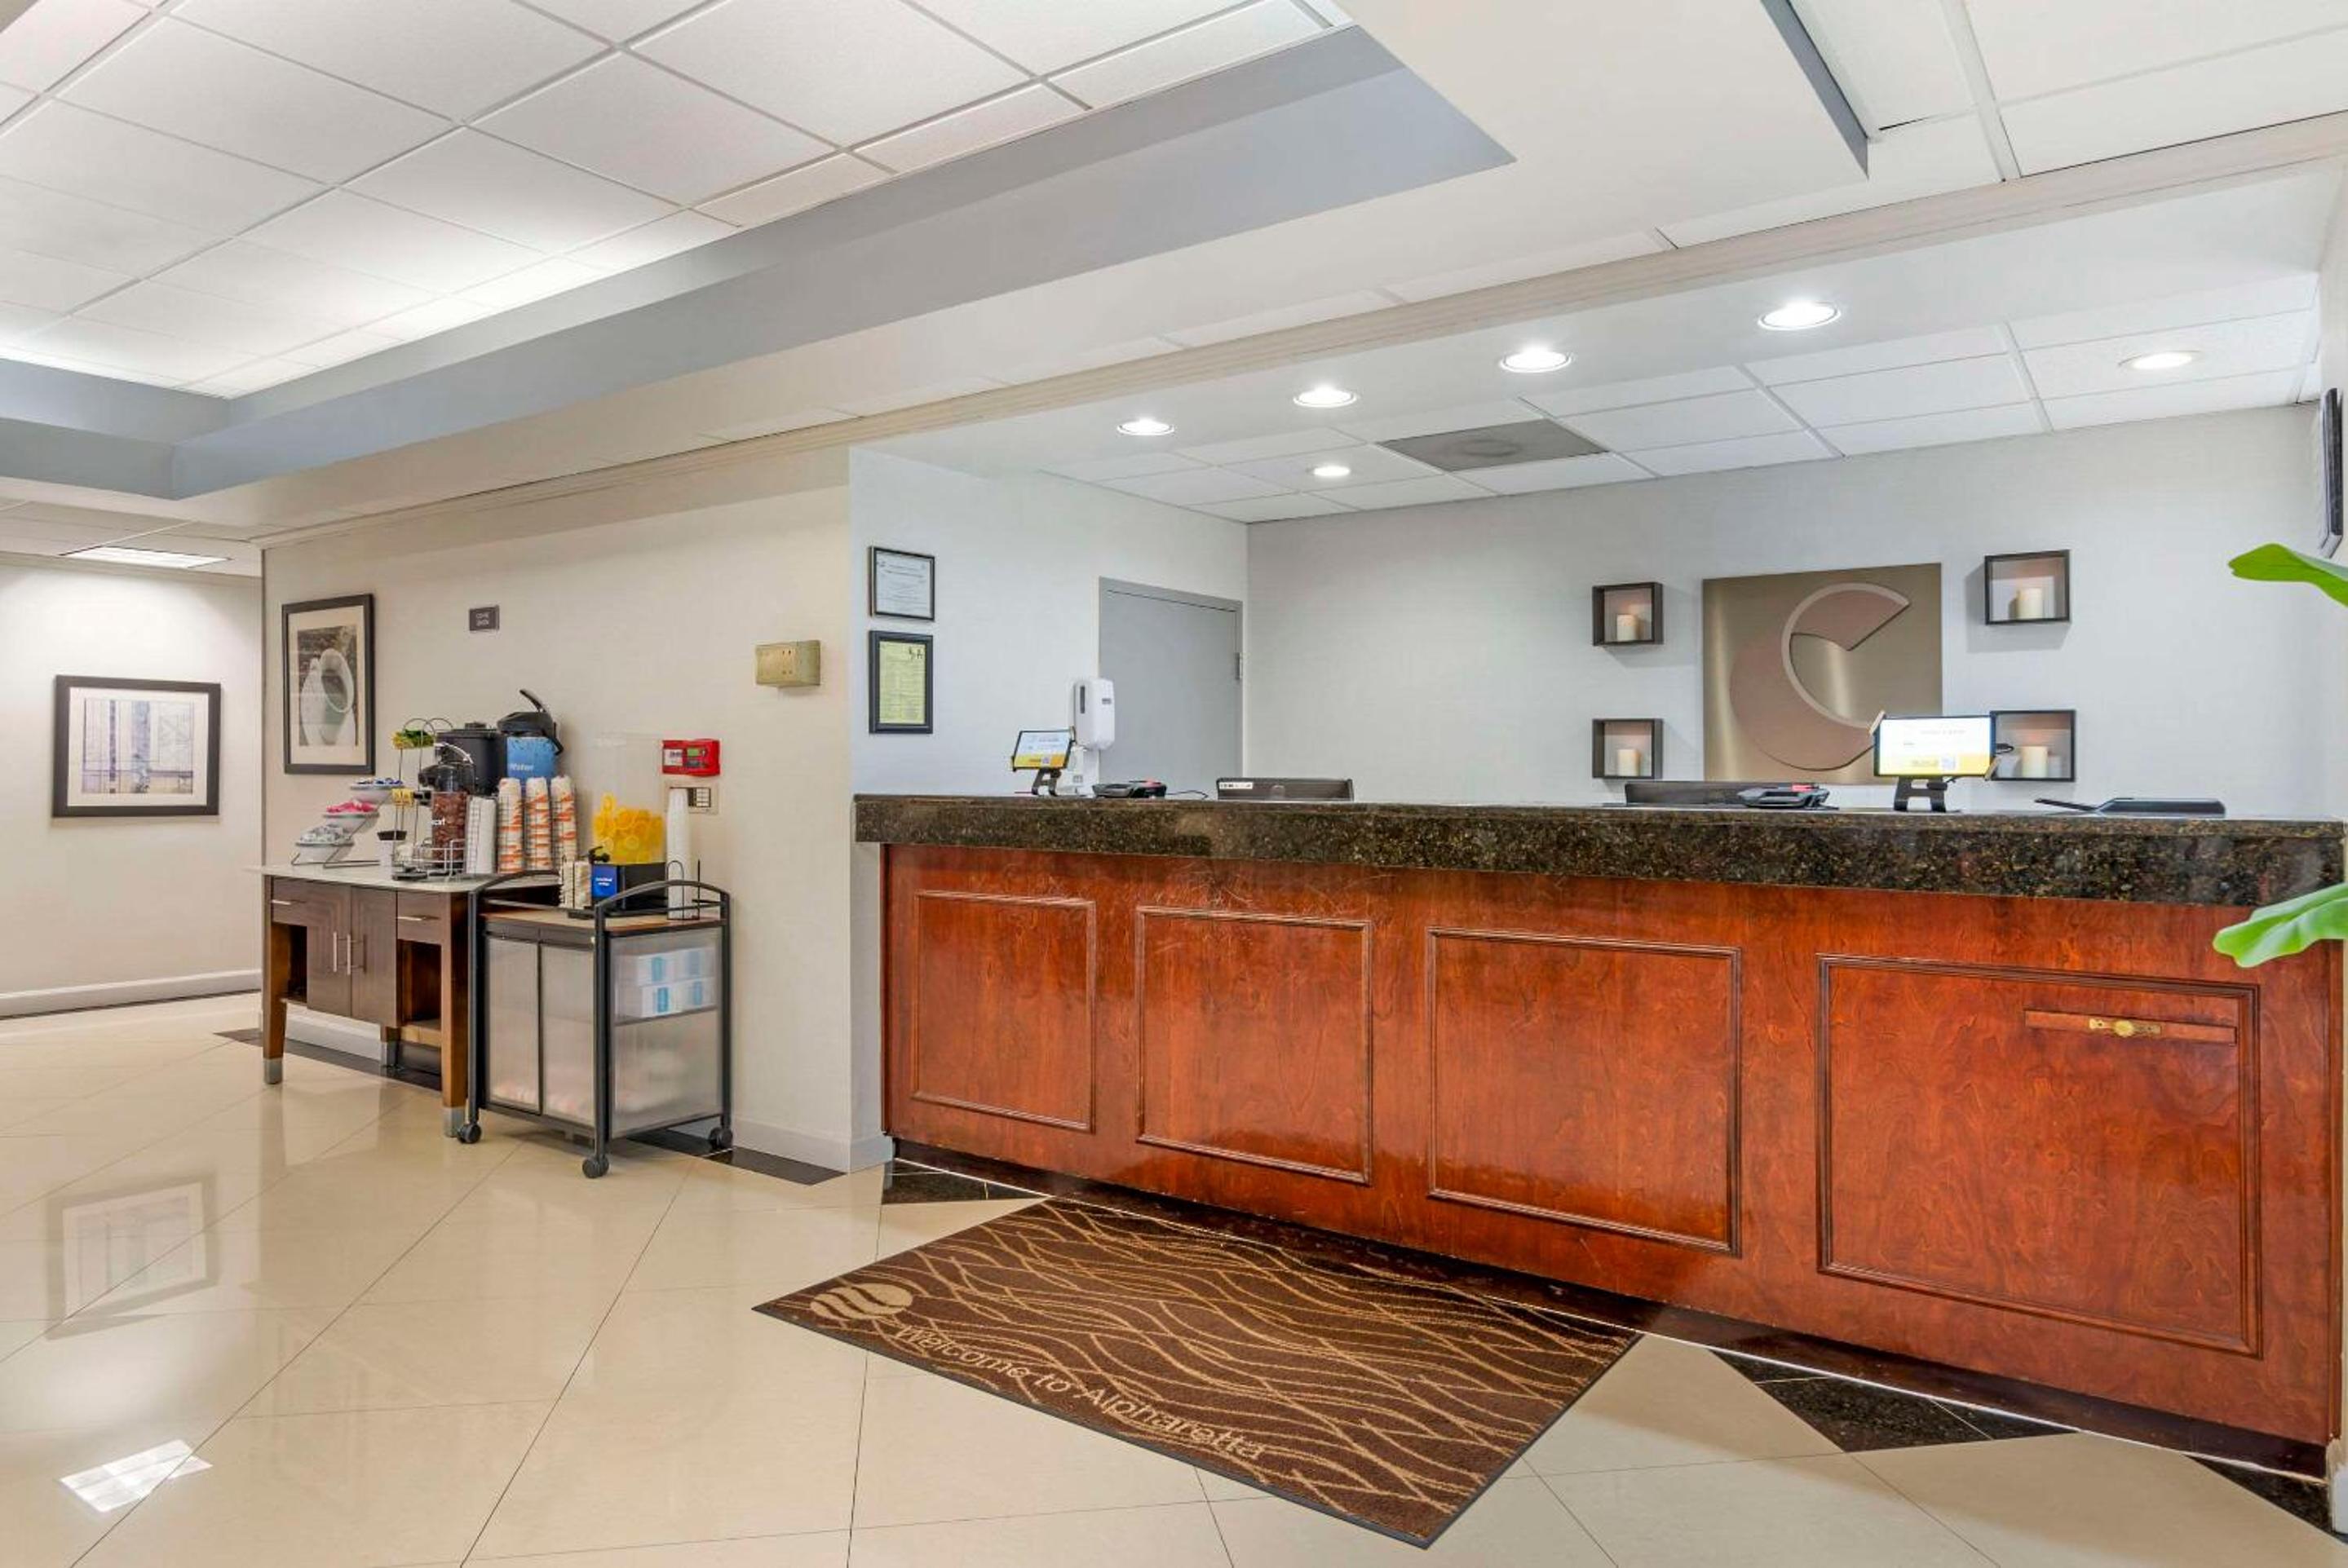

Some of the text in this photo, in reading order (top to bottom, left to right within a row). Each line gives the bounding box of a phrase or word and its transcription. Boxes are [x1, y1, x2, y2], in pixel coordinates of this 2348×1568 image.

[896, 1324, 1265, 1460] Welcome to Alpharetta
